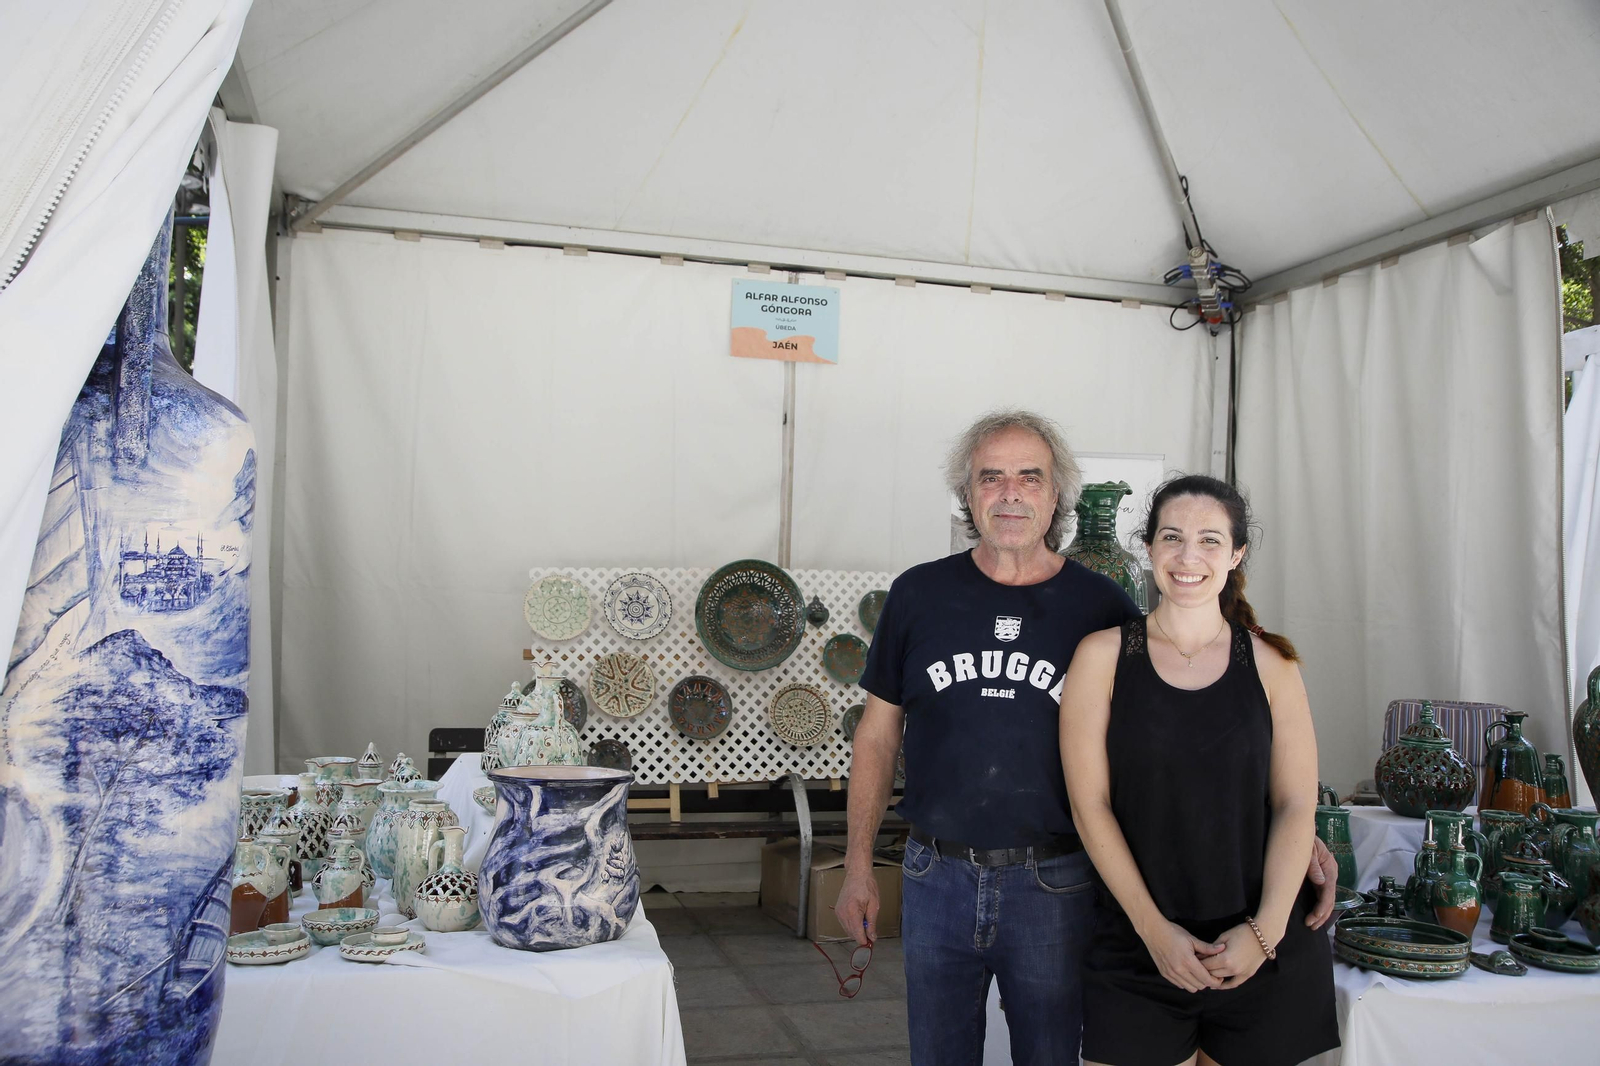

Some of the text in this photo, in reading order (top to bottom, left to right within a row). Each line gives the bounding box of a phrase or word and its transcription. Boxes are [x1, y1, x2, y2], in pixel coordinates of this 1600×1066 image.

[745, 292, 828, 306] ALFAR ALFONSO
[761, 304, 812, 316] GÓNGORA
[772, 341, 798, 351] JAÉN
[980, 688, 1016, 700] BELGIË
